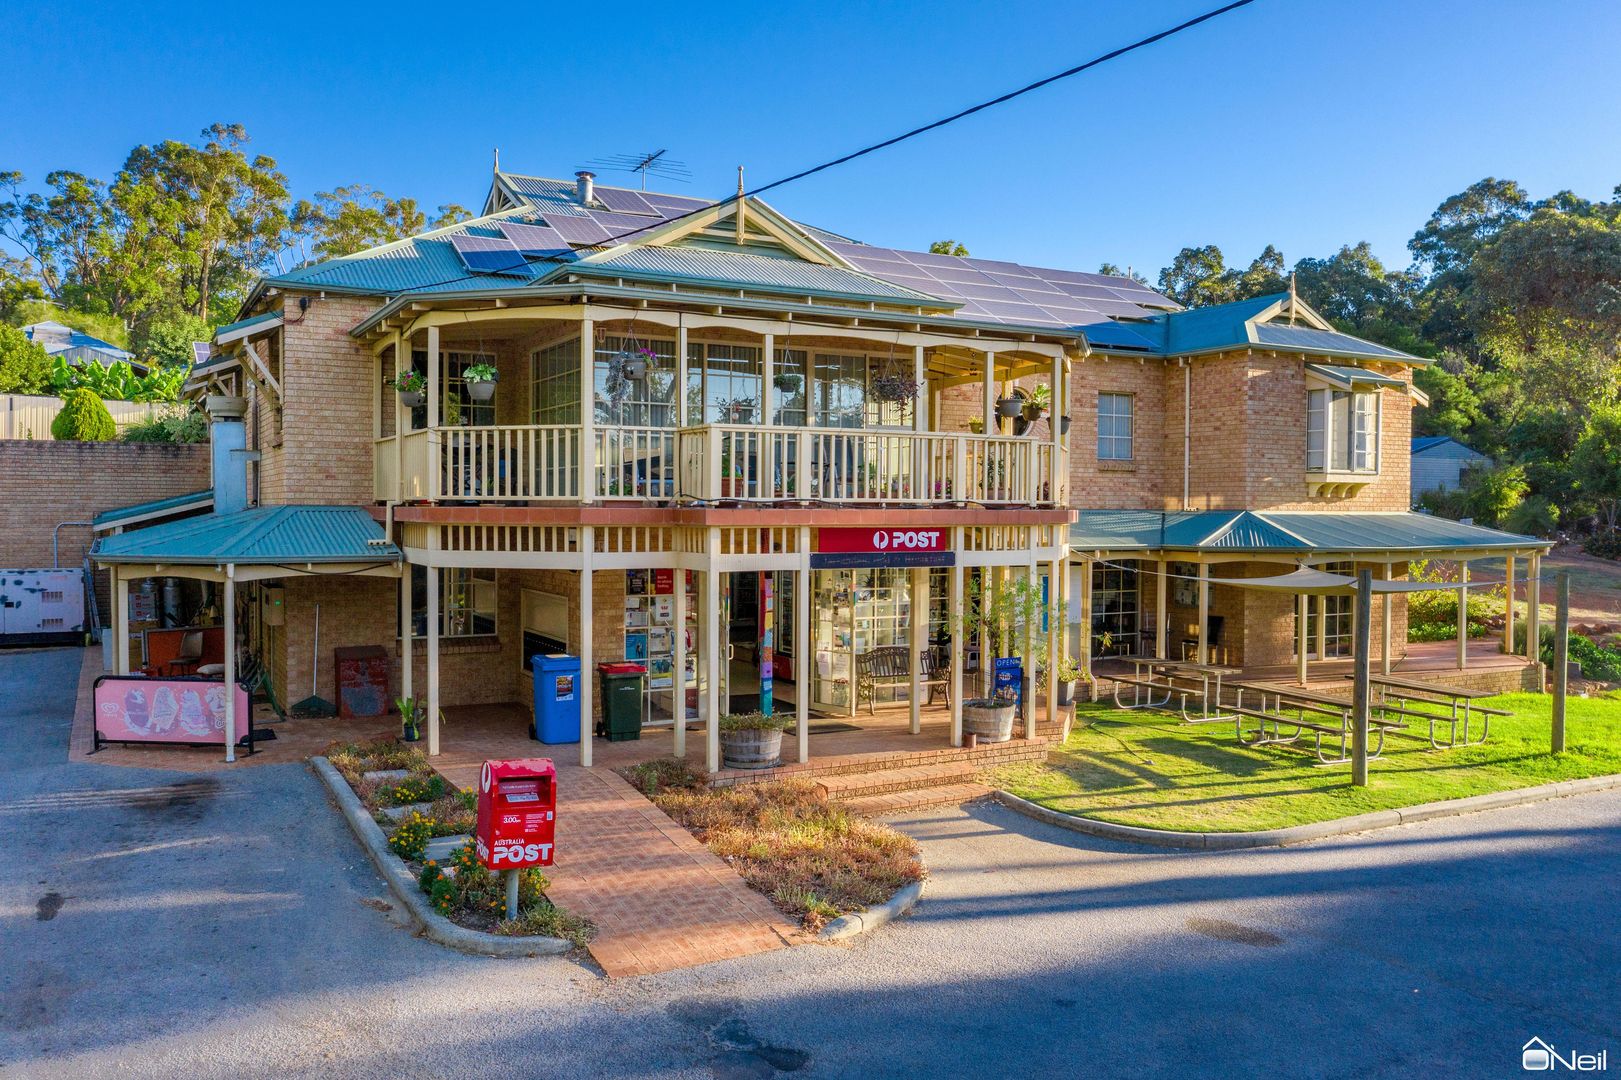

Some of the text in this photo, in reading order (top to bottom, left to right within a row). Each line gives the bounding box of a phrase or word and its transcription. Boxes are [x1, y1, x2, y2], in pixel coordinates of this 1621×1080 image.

[893, 531, 939, 548] POST
[996, 659, 1015, 667] OPEN
[493, 844, 553, 864] POST
